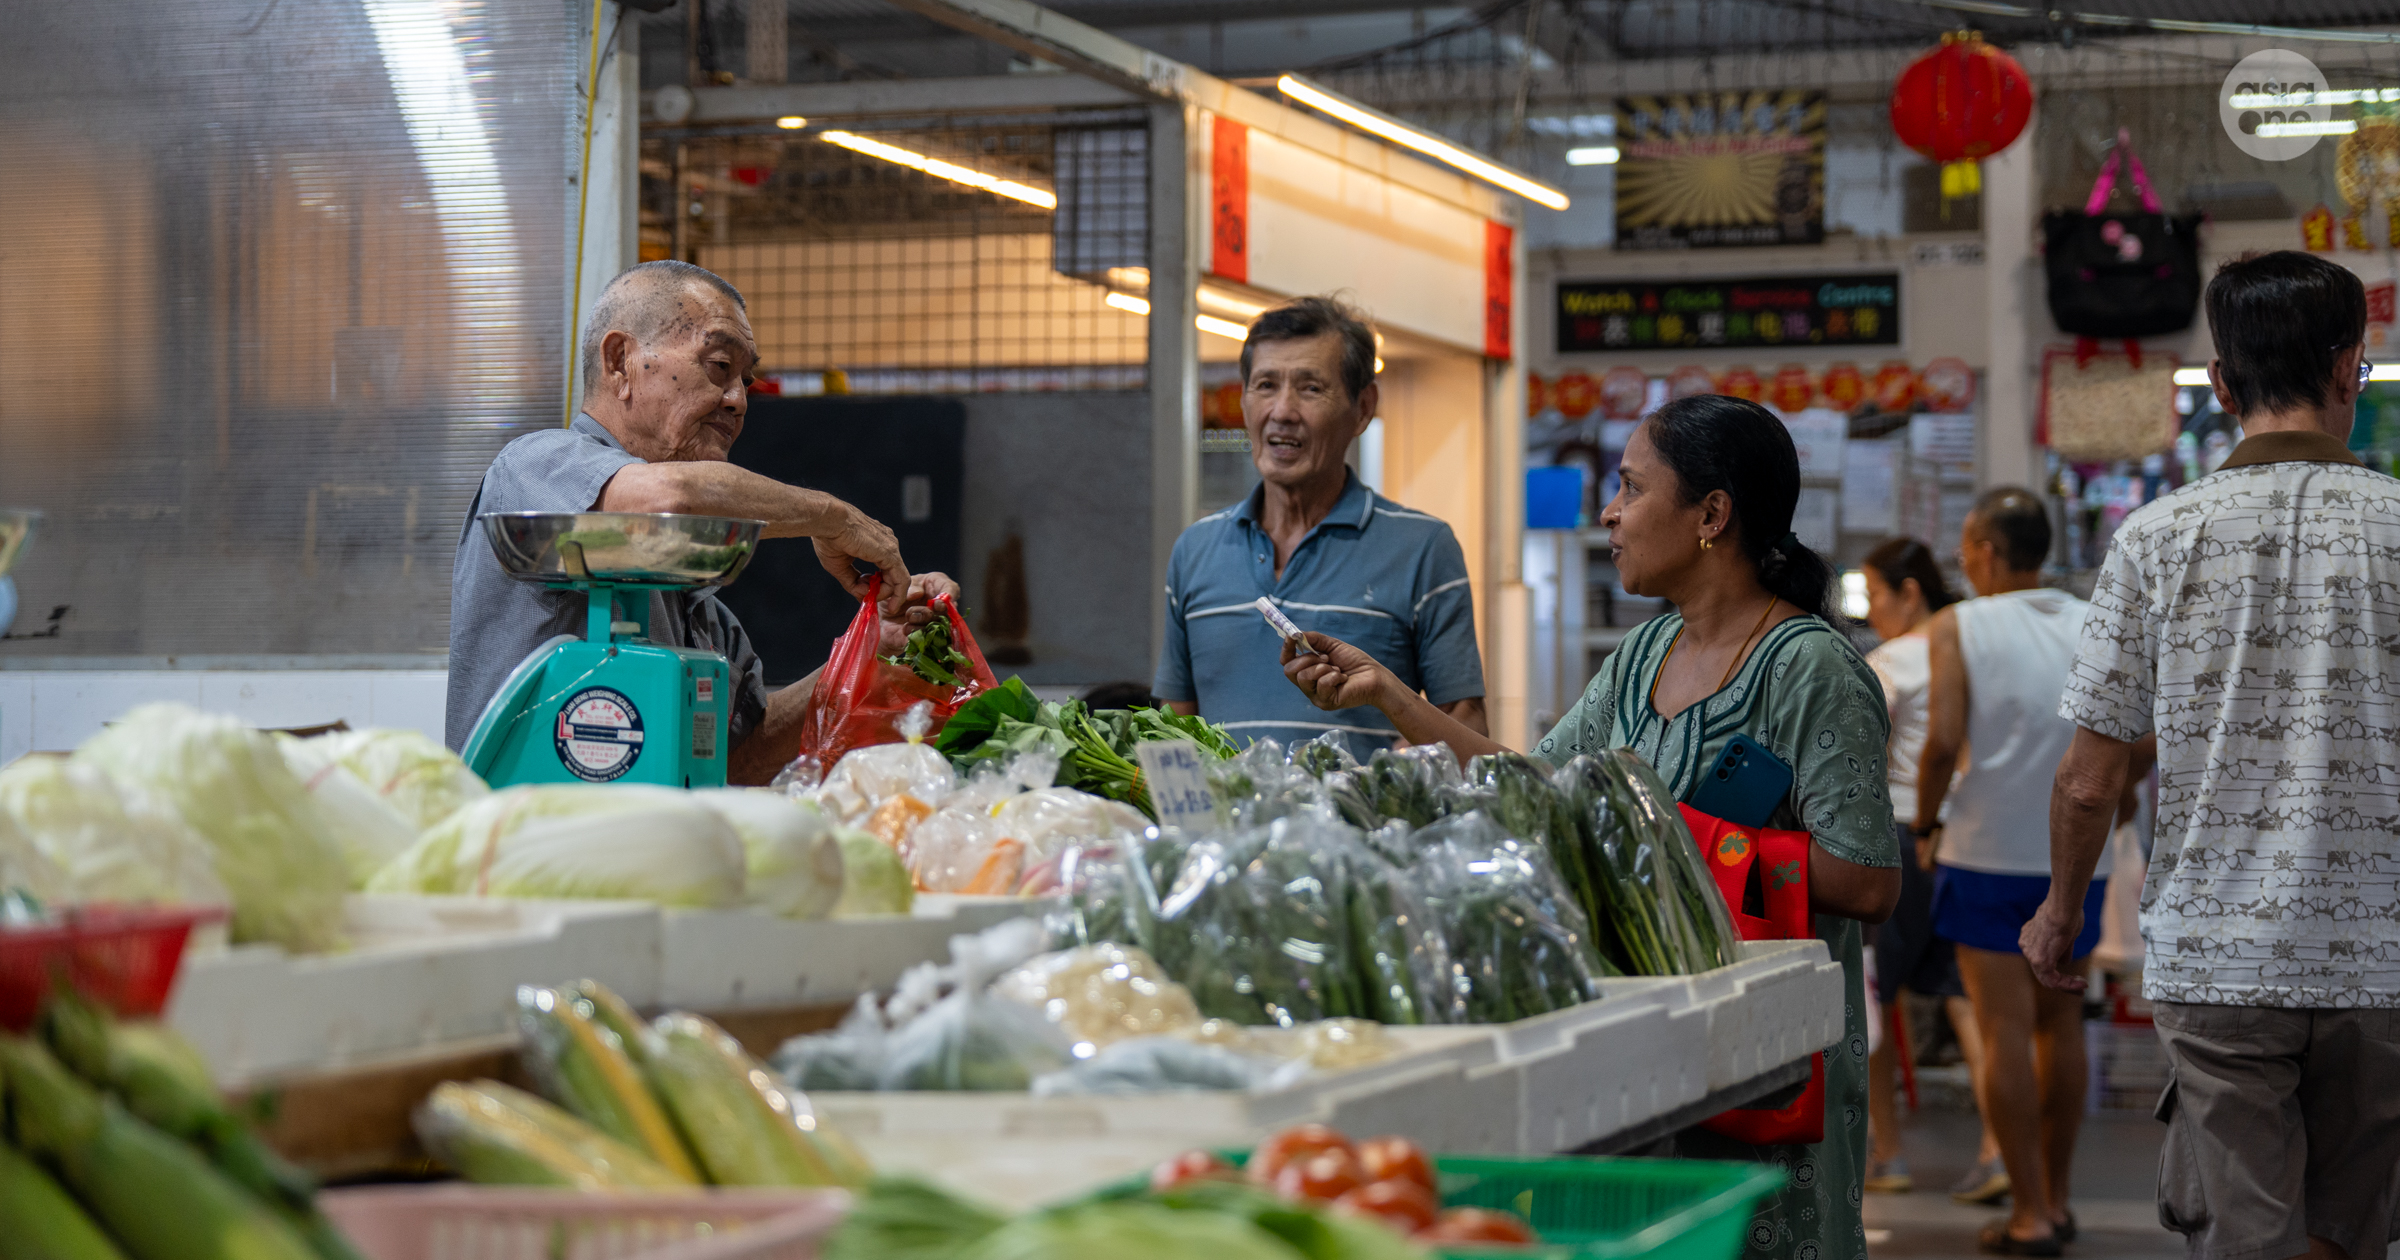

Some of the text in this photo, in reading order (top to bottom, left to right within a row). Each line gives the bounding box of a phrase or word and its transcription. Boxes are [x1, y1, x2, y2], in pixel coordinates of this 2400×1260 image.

[1562, 290, 1636, 316] Watch
[1663, 287, 1723, 312] Clock
[616, 696, 632, 712] SCALE
